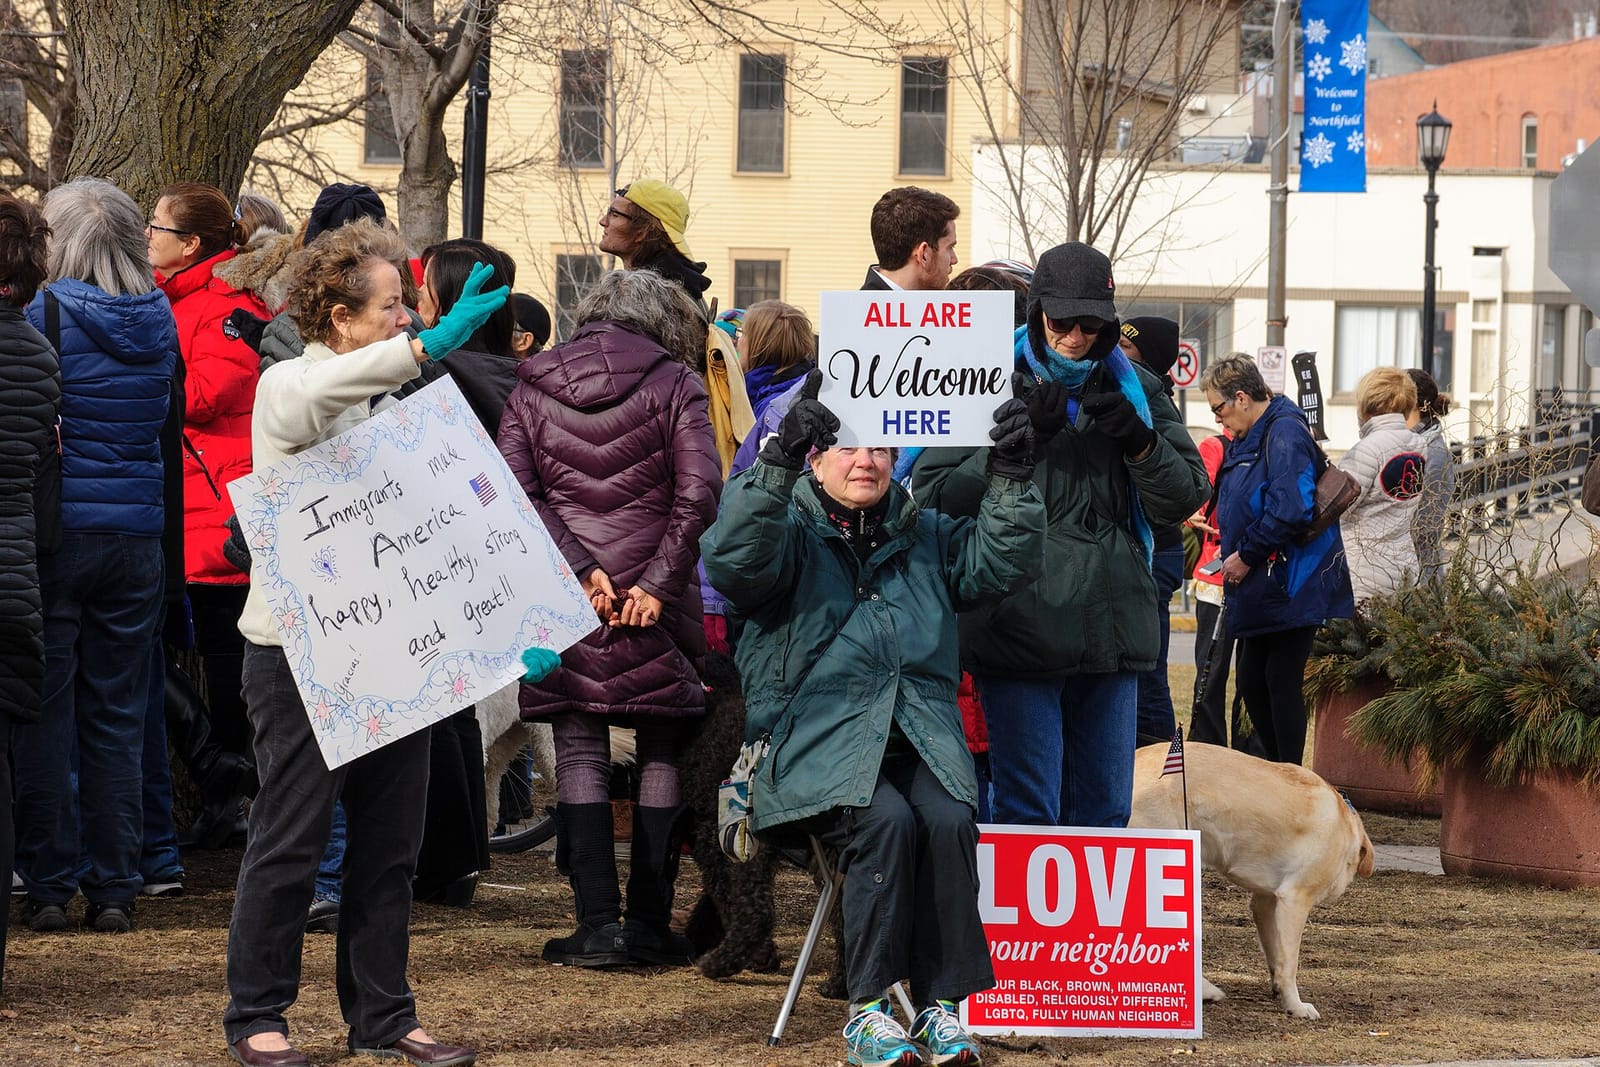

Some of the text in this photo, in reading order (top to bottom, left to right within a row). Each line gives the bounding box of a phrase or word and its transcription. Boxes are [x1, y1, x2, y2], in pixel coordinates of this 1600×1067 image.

[1314, 86, 1358, 98] Welcome
[1331, 103, 1342, 112] to
[1308, 114, 1362, 129] Northfield
[864, 302, 972, 328] ALL ARE
[828, 335, 1007, 399] Welcome
[882, 410, 950, 435] HERE
[298, 469, 404, 541] Immigrants
[368, 503, 467, 569] America
[307, 522, 528, 638] happy, healthy, strong
[408, 574, 516, 657] and great!!
[976, 843, 1188, 929] LOVE
[1020, 980, 1063, 992] BLACK,
[1066, 981, 1114, 993] BROWN,
[1117, 982, 1187, 995] IMMIGRANT,
[976, 993, 1188, 1009] DISABLED, RELIGIOUSLY DIFFERENT,
[985, 1008, 1179, 1022] LGBTQ, FULLY HUMAN NEIGHBOR
